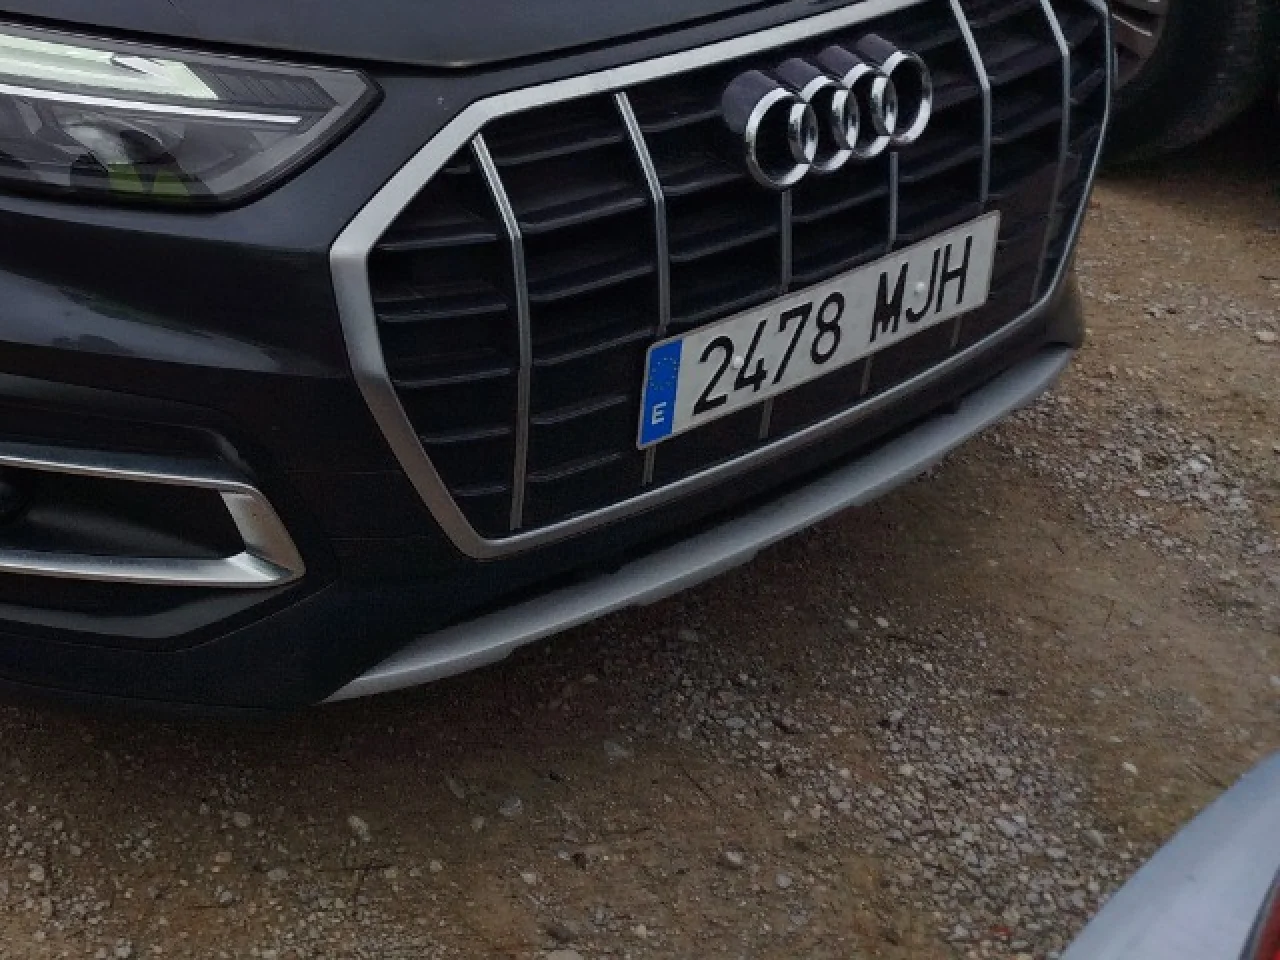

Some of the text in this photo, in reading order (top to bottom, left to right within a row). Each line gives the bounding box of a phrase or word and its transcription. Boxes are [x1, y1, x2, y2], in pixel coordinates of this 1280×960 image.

[693, 236, 972, 416] 2478 MJH
[651, 401, 667, 426] E
